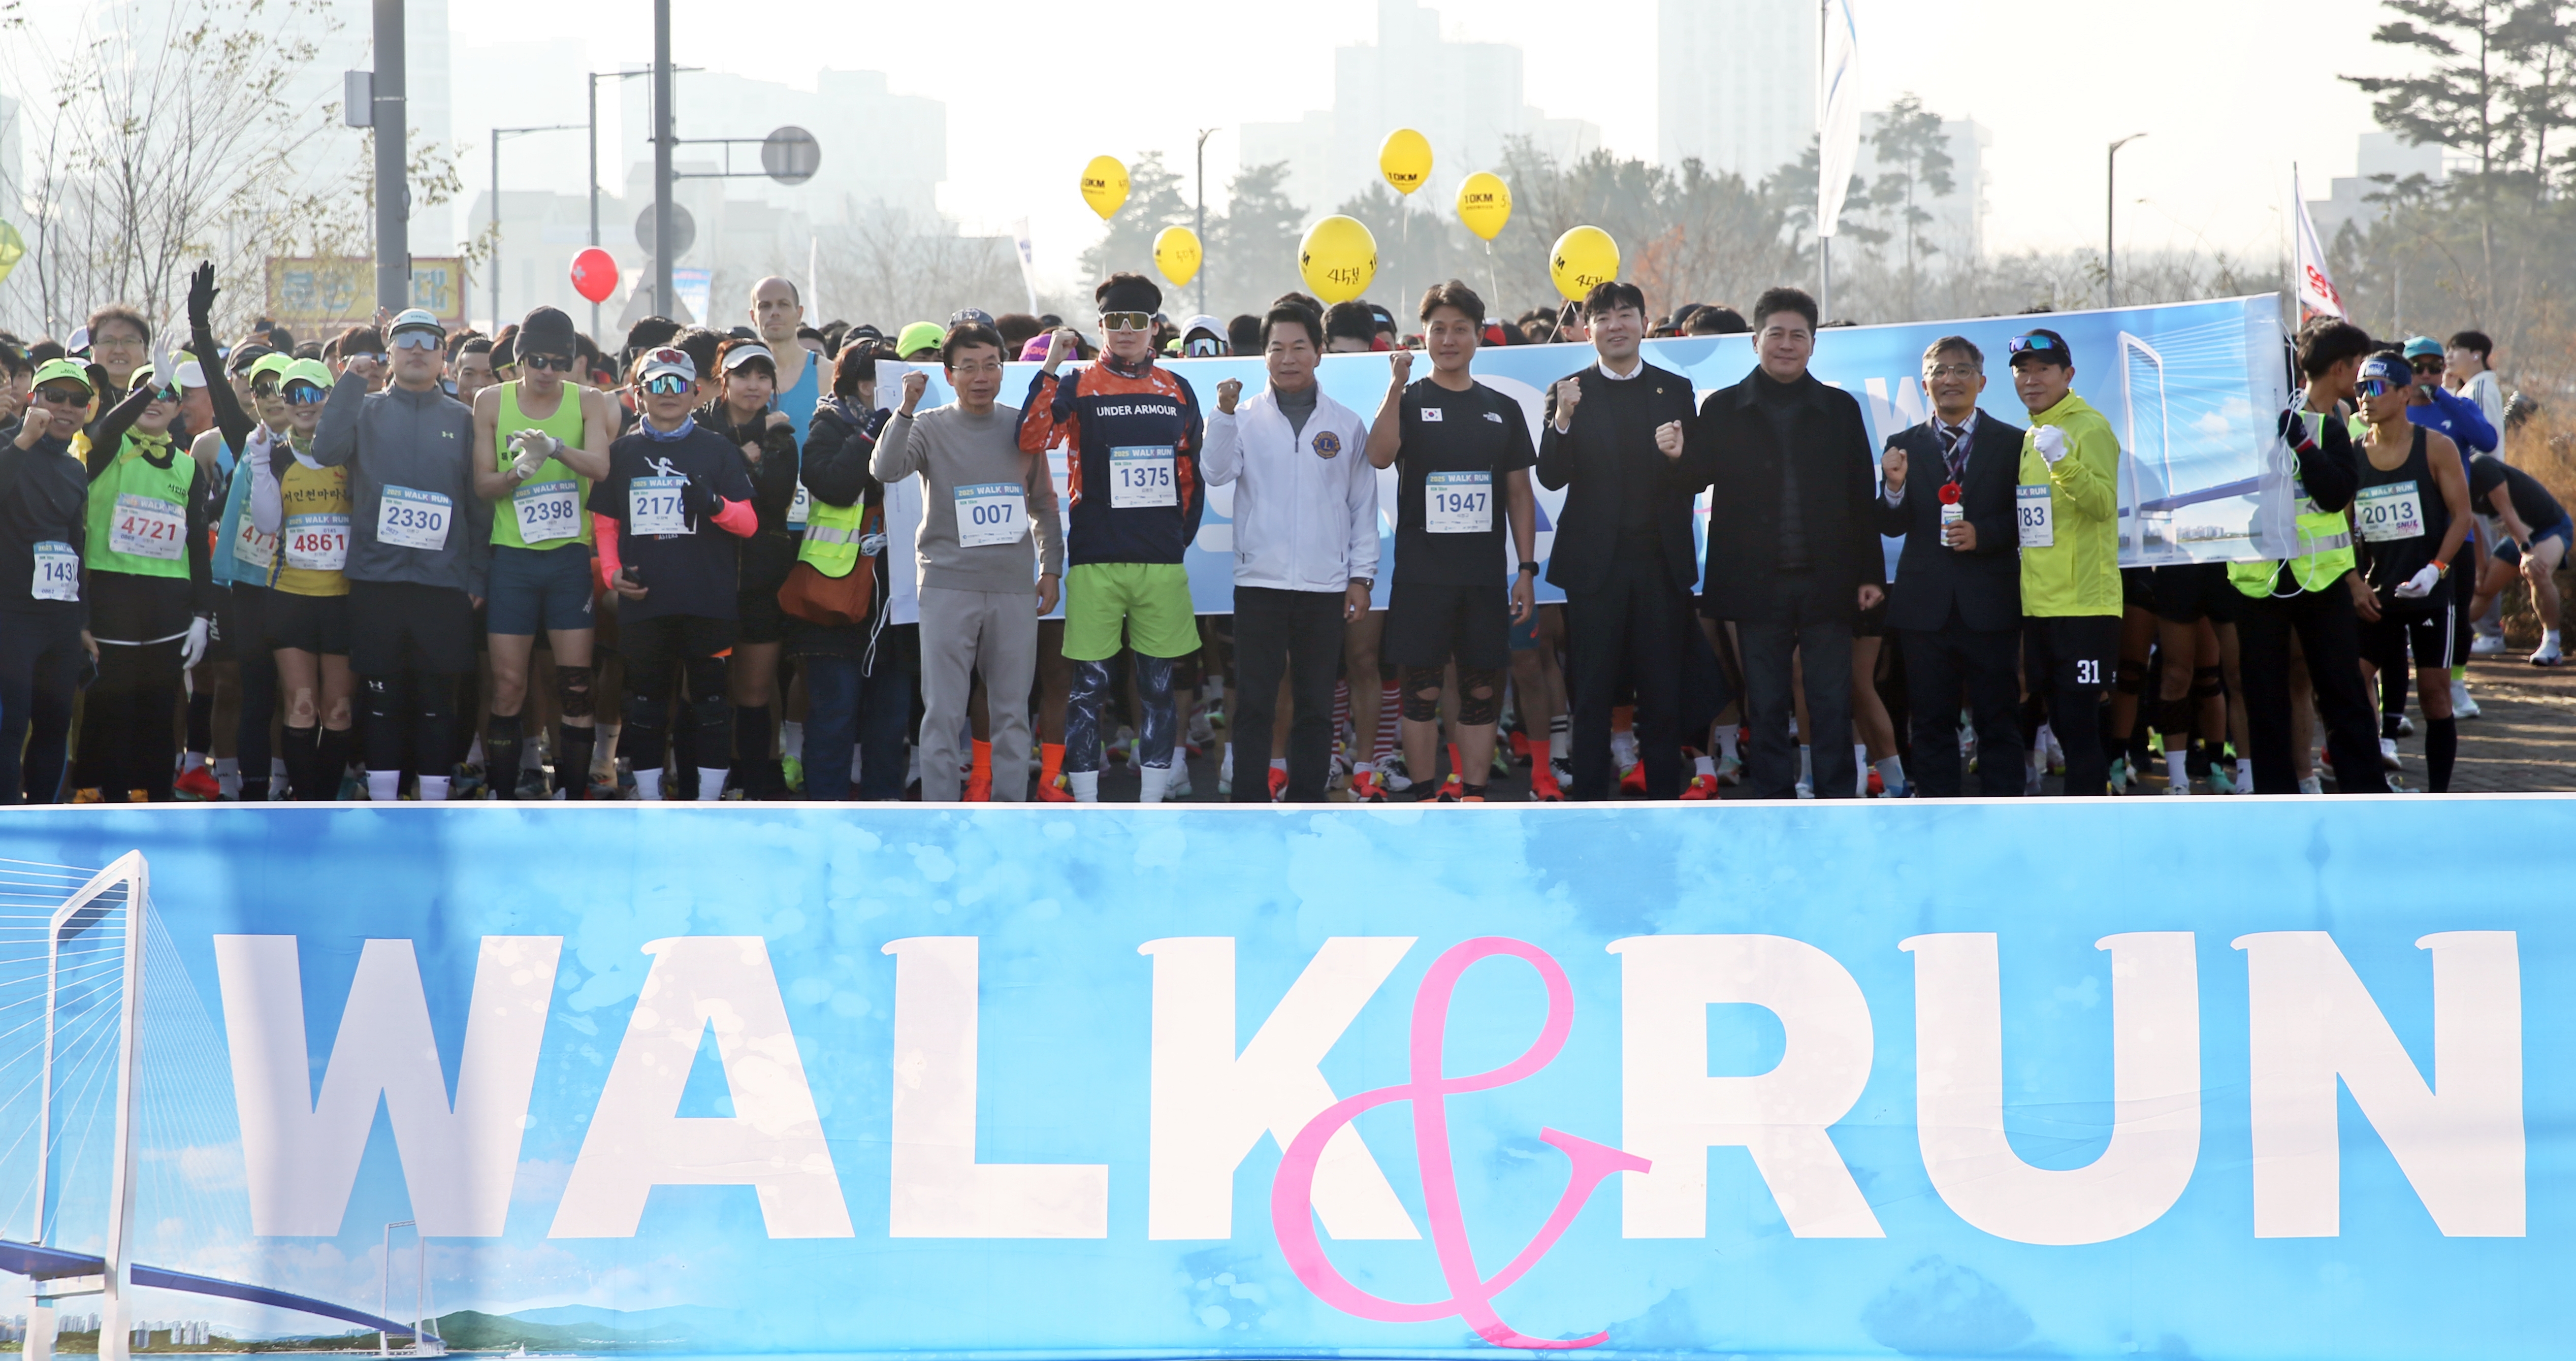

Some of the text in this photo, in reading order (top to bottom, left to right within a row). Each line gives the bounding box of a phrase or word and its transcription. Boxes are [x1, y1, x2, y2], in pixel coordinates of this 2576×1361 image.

[1464, 193, 1493, 204] 10KM
[1096, 405, 1177, 416] UNDER ARMOUR
[1120, 467, 1169, 487] 1375
[404, 490, 428, 501] WALK
[431, 495, 449, 503] RUN
[533, 484, 557, 494] WALK
[977, 487, 1002, 495] WALK
[524, 500, 573, 524] 2398
[1436, 493, 1486, 512] 1947
[2363, 501, 2413, 524] 2013
[387, 507, 442, 531] 2330
[973, 504, 1012, 525] 007
[121, 515, 176, 541] 4721
[294, 534, 345, 553] 4861
[2077, 660, 2100, 684] 31
[214, 935, 1422, 1240] WALK
[1605, 930, 2526, 1245] RUN
